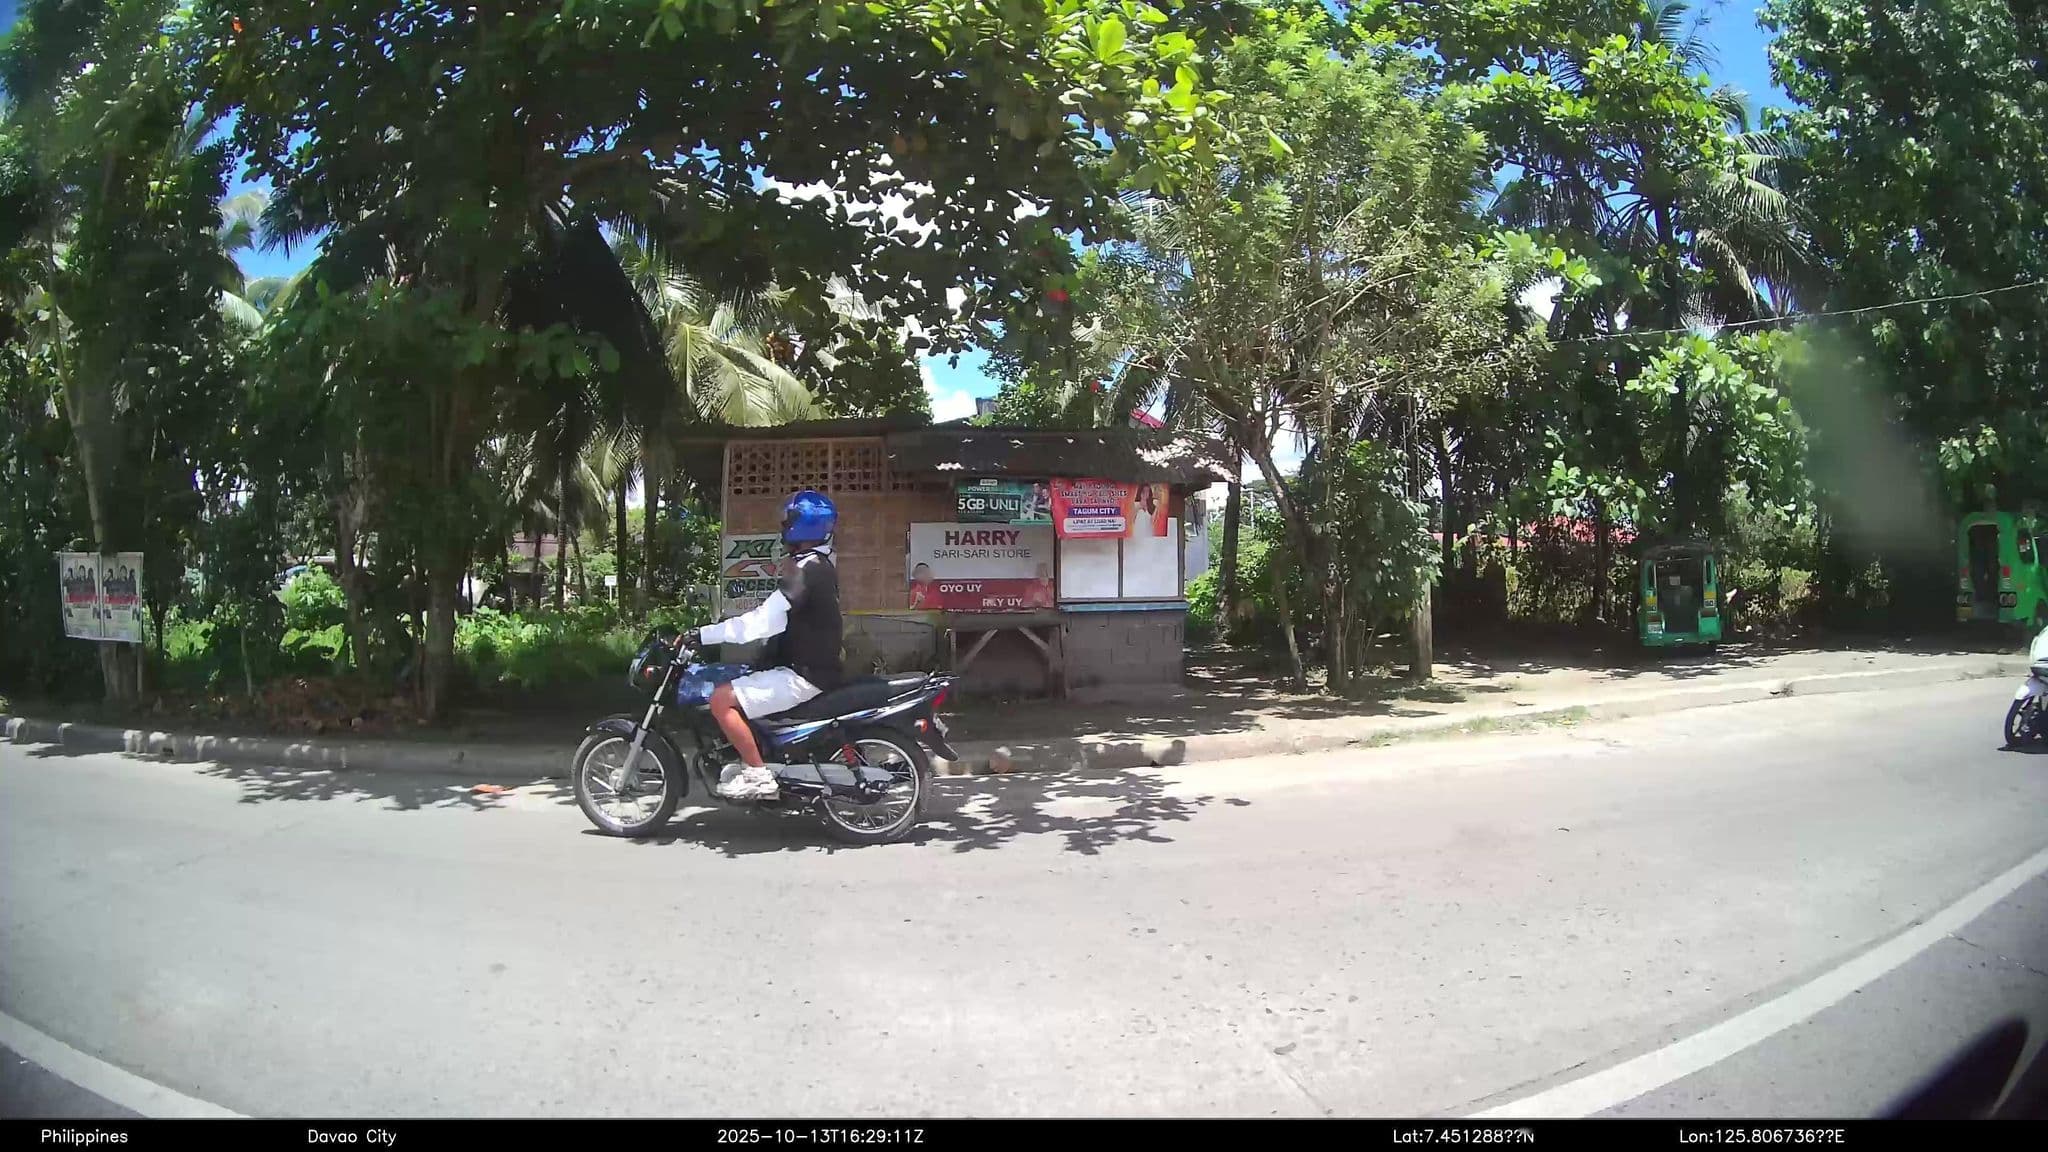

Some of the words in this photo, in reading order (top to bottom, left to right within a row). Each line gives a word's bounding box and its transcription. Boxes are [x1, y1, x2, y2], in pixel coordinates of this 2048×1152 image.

[1073, 507, 1099, 515] TAGUM
[1100, 507, 1116, 515] CITY
[944, 530, 1021, 546] HARRY
[933, 549, 990, 559] SARI-SARI
[993, 548, 1032, 558] STORE
[940, 584, 964, 593] OYO
[966, 584, 982, 593] UY
[1007, 598, 1023, 607] UY
